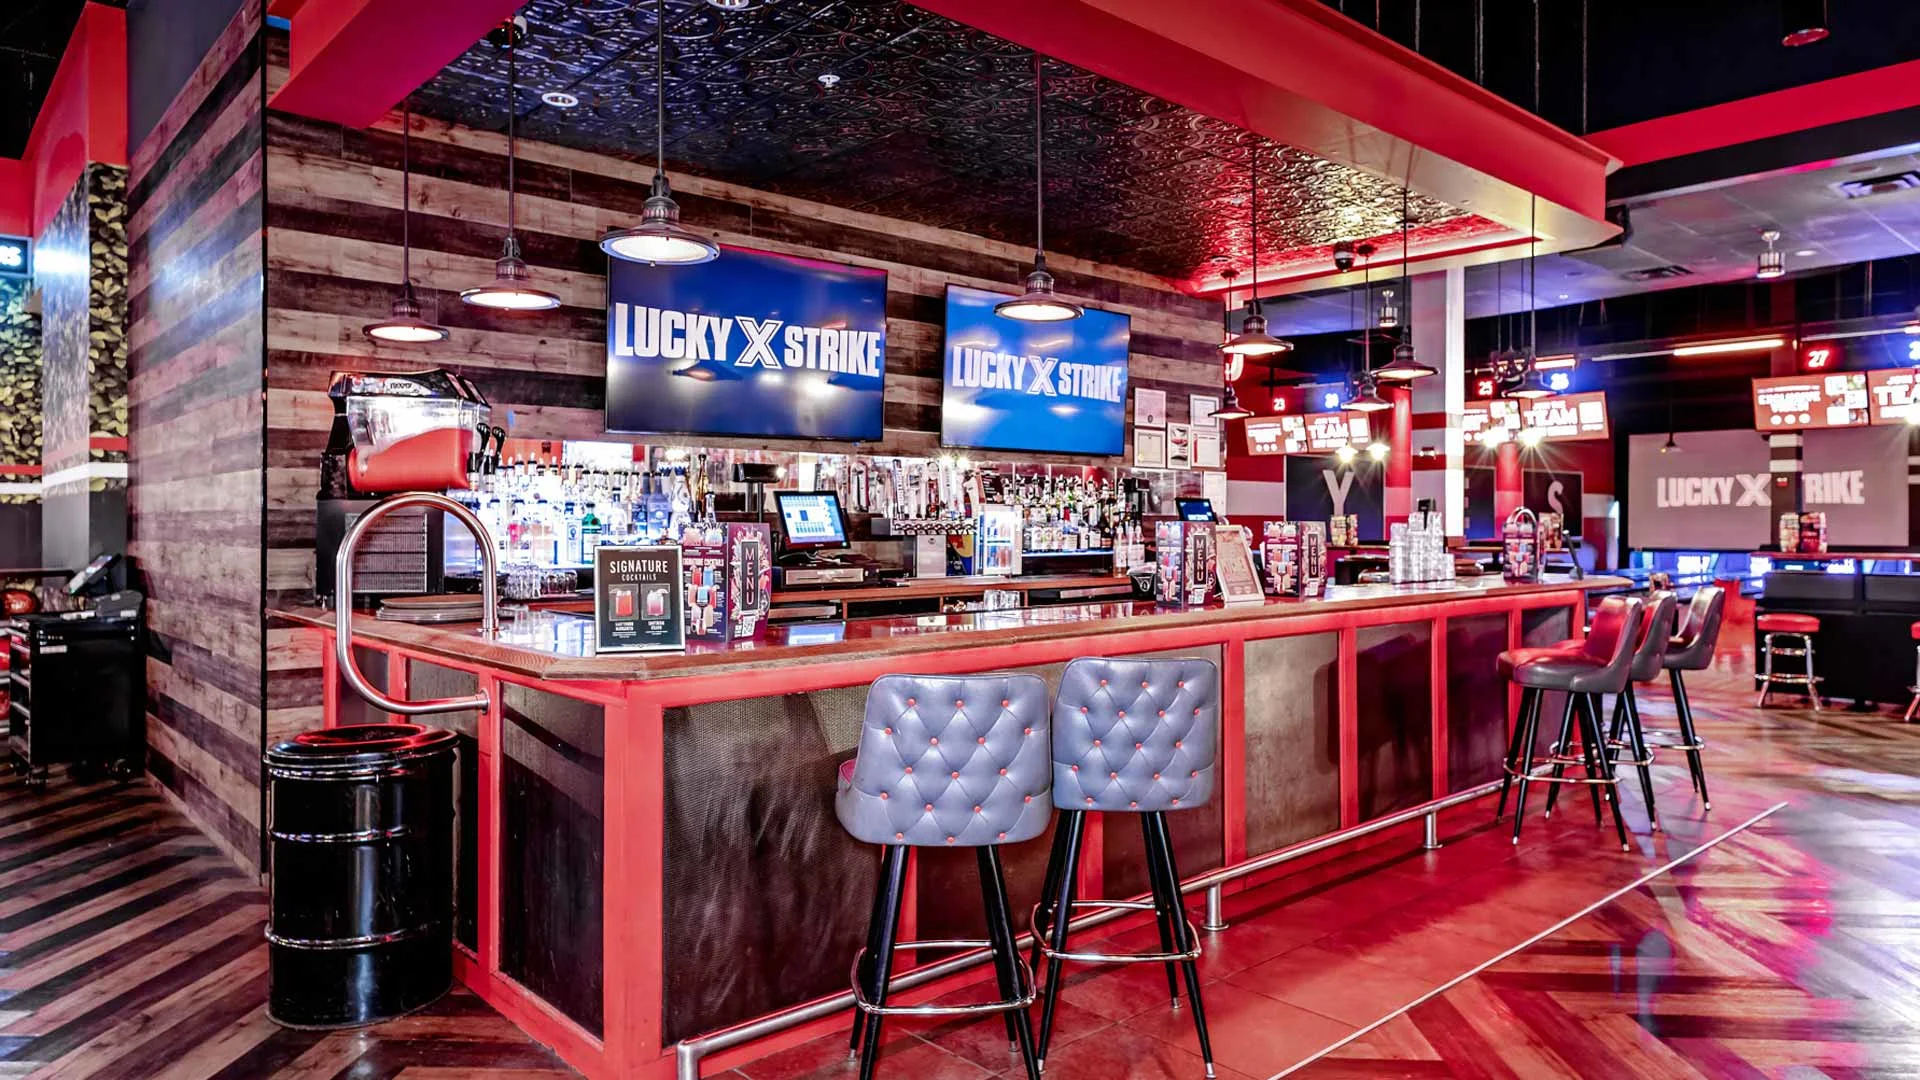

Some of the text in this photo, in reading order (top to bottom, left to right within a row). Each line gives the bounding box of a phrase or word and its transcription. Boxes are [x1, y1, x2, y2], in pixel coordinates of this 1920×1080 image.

[615, 302, 881, 377] LUCKY X STRIKE
[1808, 350, 1829, 368] 27
[952, 346, 1026, 391] LUCKY
[1027, 355, 1059, 397] X
[1058, 362, 1123, 403] STRIKE
[1478, 380, 1493, 396] 25
[1273, 398, 1285, 411] 23
[1523, 407, 1578, 426] TEAM
[1307, 423, 1349, 440] TEAM
[1322, 469, 1355, 516] Y
[1657, 470, 1865, 508] LUCKY X RIKE
[609, 559, 669, 574] SIGNATURE
[621, 573, 657, 581] COCKTAILS
[746, 547, 755, 605] MENU
